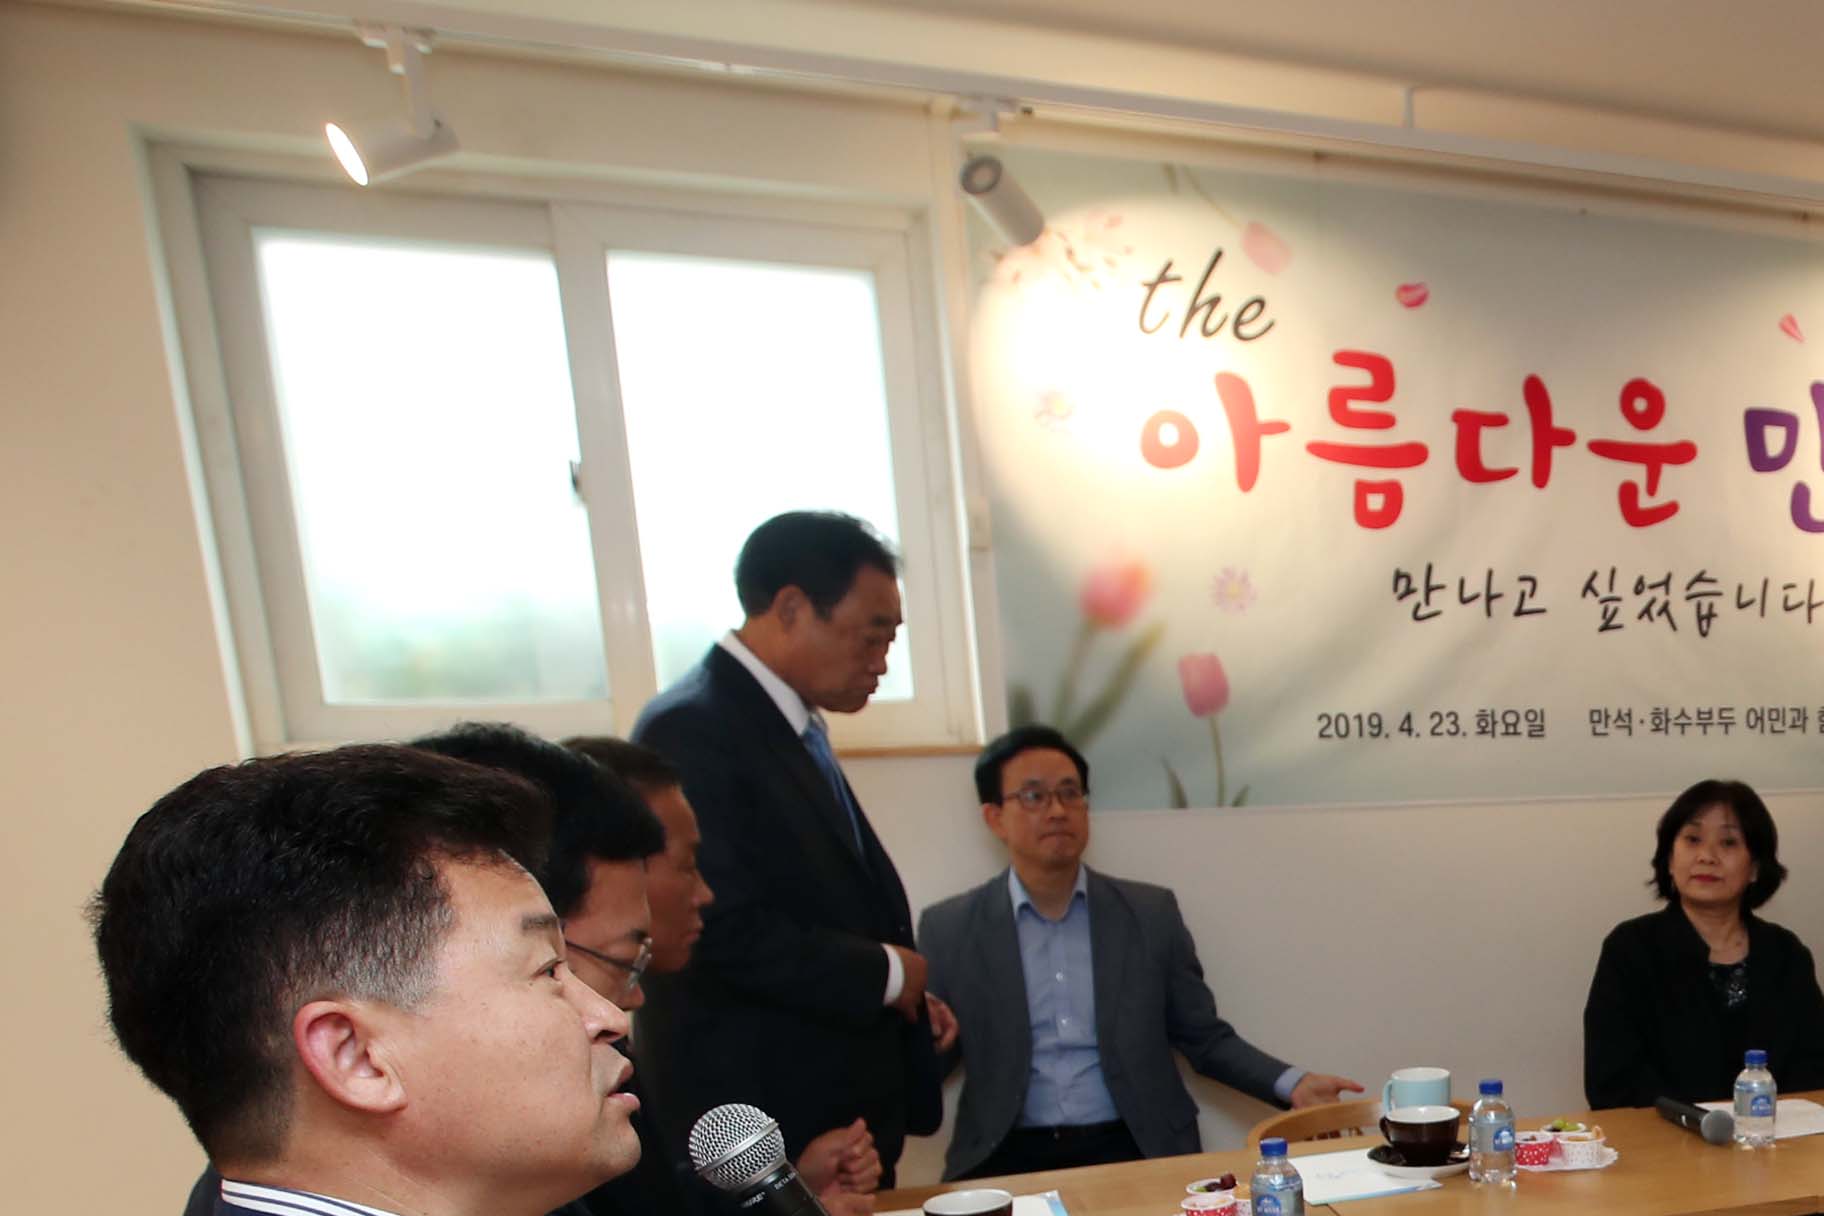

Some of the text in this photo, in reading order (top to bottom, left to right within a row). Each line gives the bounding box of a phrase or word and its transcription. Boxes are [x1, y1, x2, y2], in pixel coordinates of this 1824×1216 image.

[1138, 246, 1276, 342] the
[1139, 348, 1698, 530] 아름다운
[1392, 562, 1548, 622] 만나고
[1316, 711, 1391, 740] 2019.
[1429, 710, 1468, 738] 23.
[1474, 707, 1546, 739] 화요일
[1745, 705, 1810, 735] 어민과
